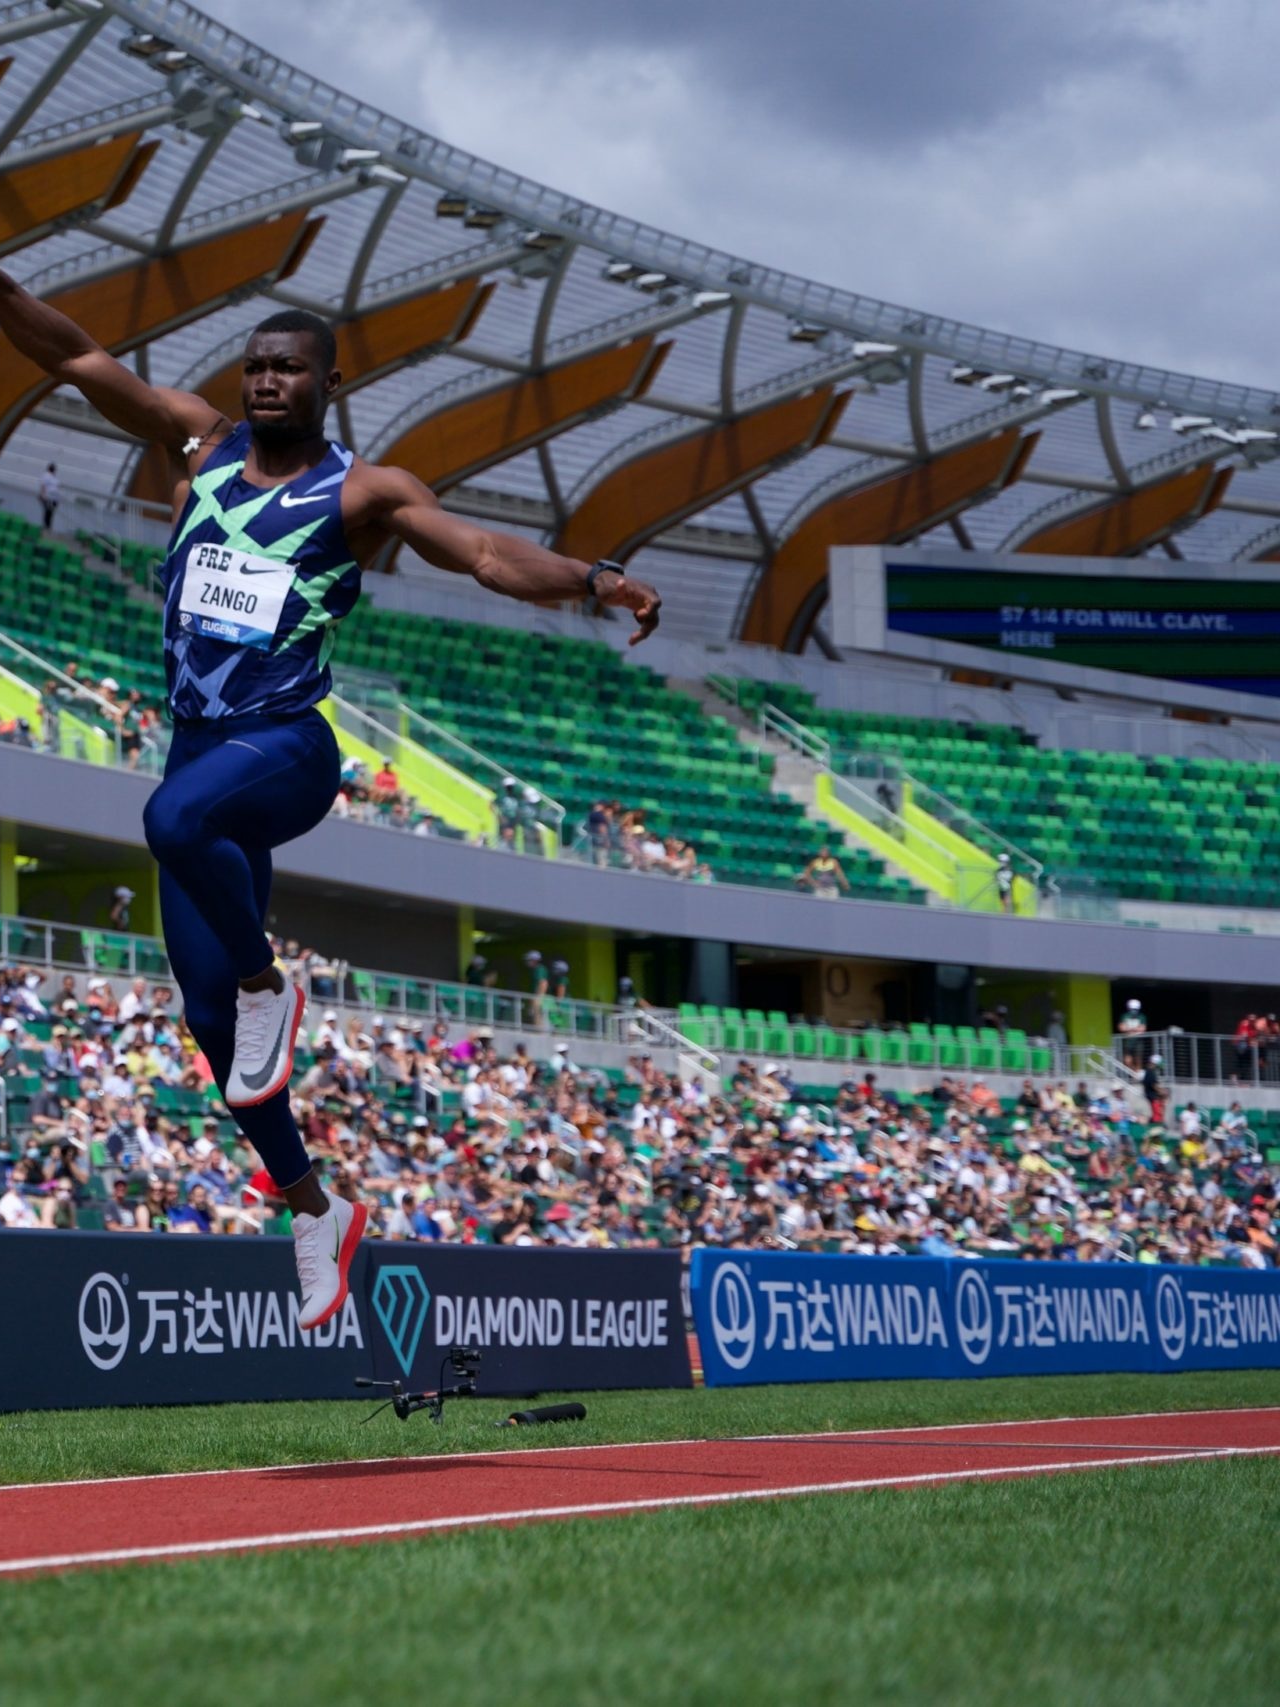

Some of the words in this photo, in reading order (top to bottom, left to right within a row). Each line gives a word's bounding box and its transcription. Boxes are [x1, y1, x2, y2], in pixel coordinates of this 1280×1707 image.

[197, 547, 232, 572] PRE
[200, 583, 258, 614] ZANGO
[202, 620, 240, 637] EUGENE
[1063, 609, 1103, 627] FOR
[1108, 611, 1157, 629] WILL
[1000, 630, 1056, 648] HERE
[435, 1295, 563, 1347] DIAMOND
[570, 1298, 669, 1347] LEAGUE
